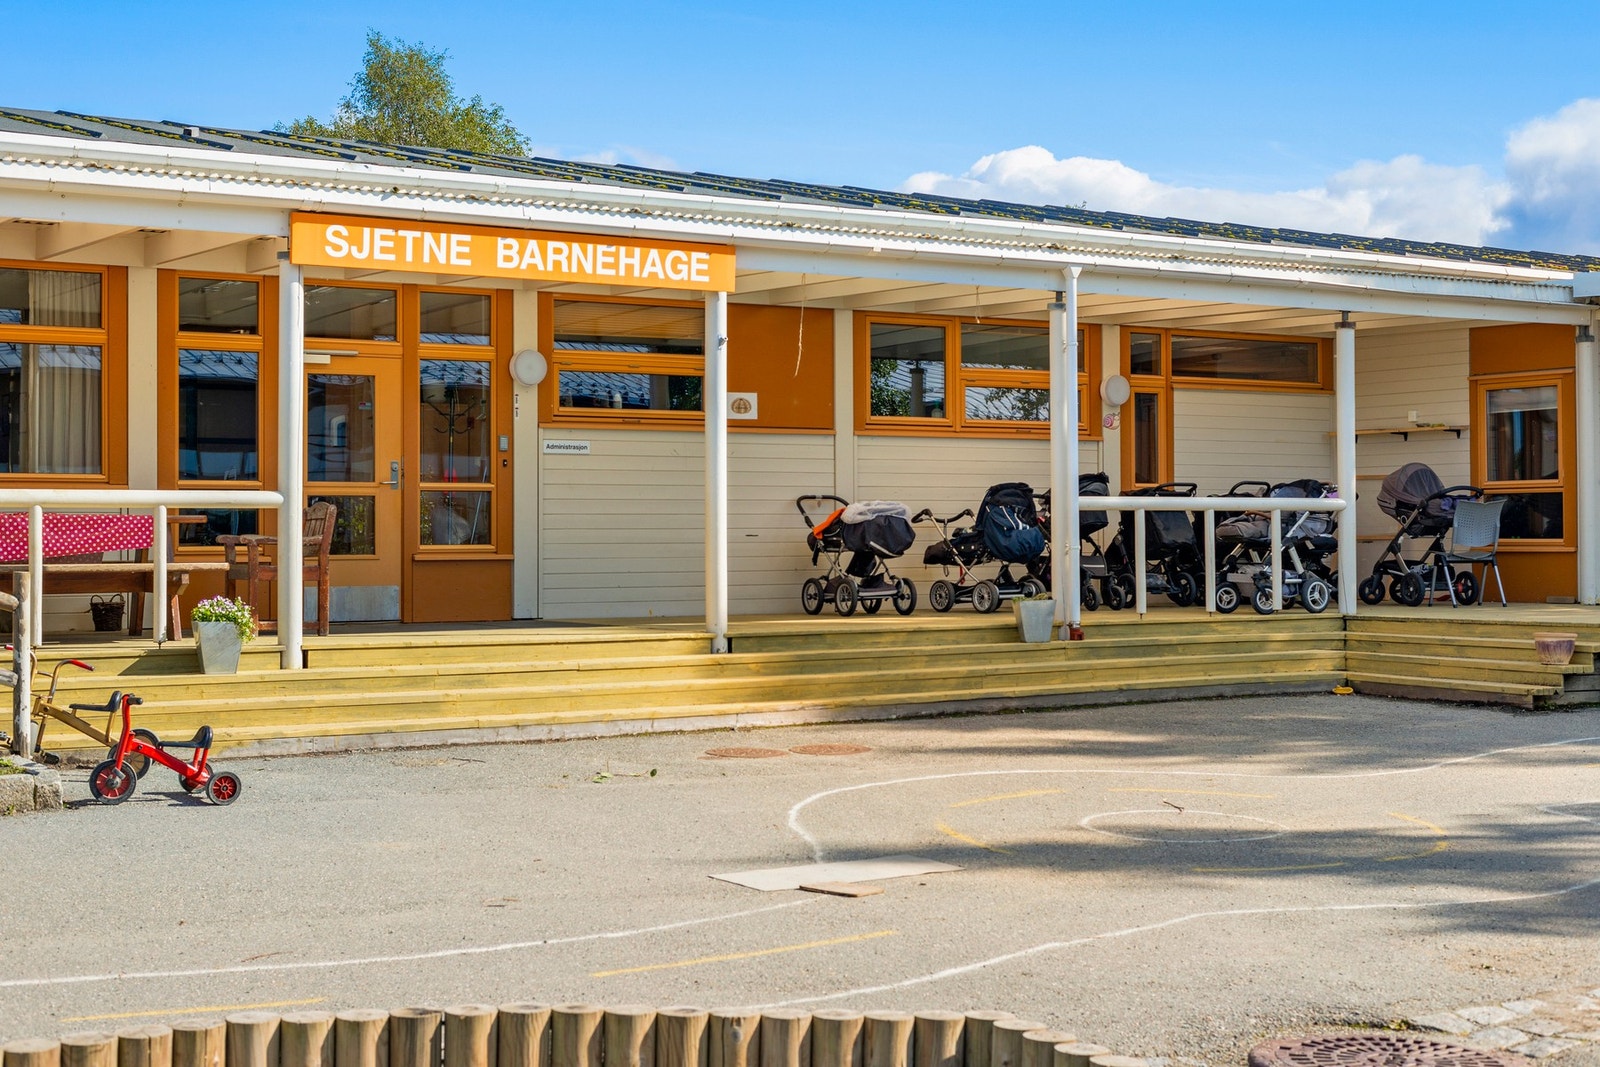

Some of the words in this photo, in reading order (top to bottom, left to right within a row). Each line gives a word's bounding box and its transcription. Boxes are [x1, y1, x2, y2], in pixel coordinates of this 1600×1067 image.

[324, 224, 472, 266] SJETNE
[496, 237, 710, 282] BARNEHAGE
[545, 443, 588, 451] Administrasjon
